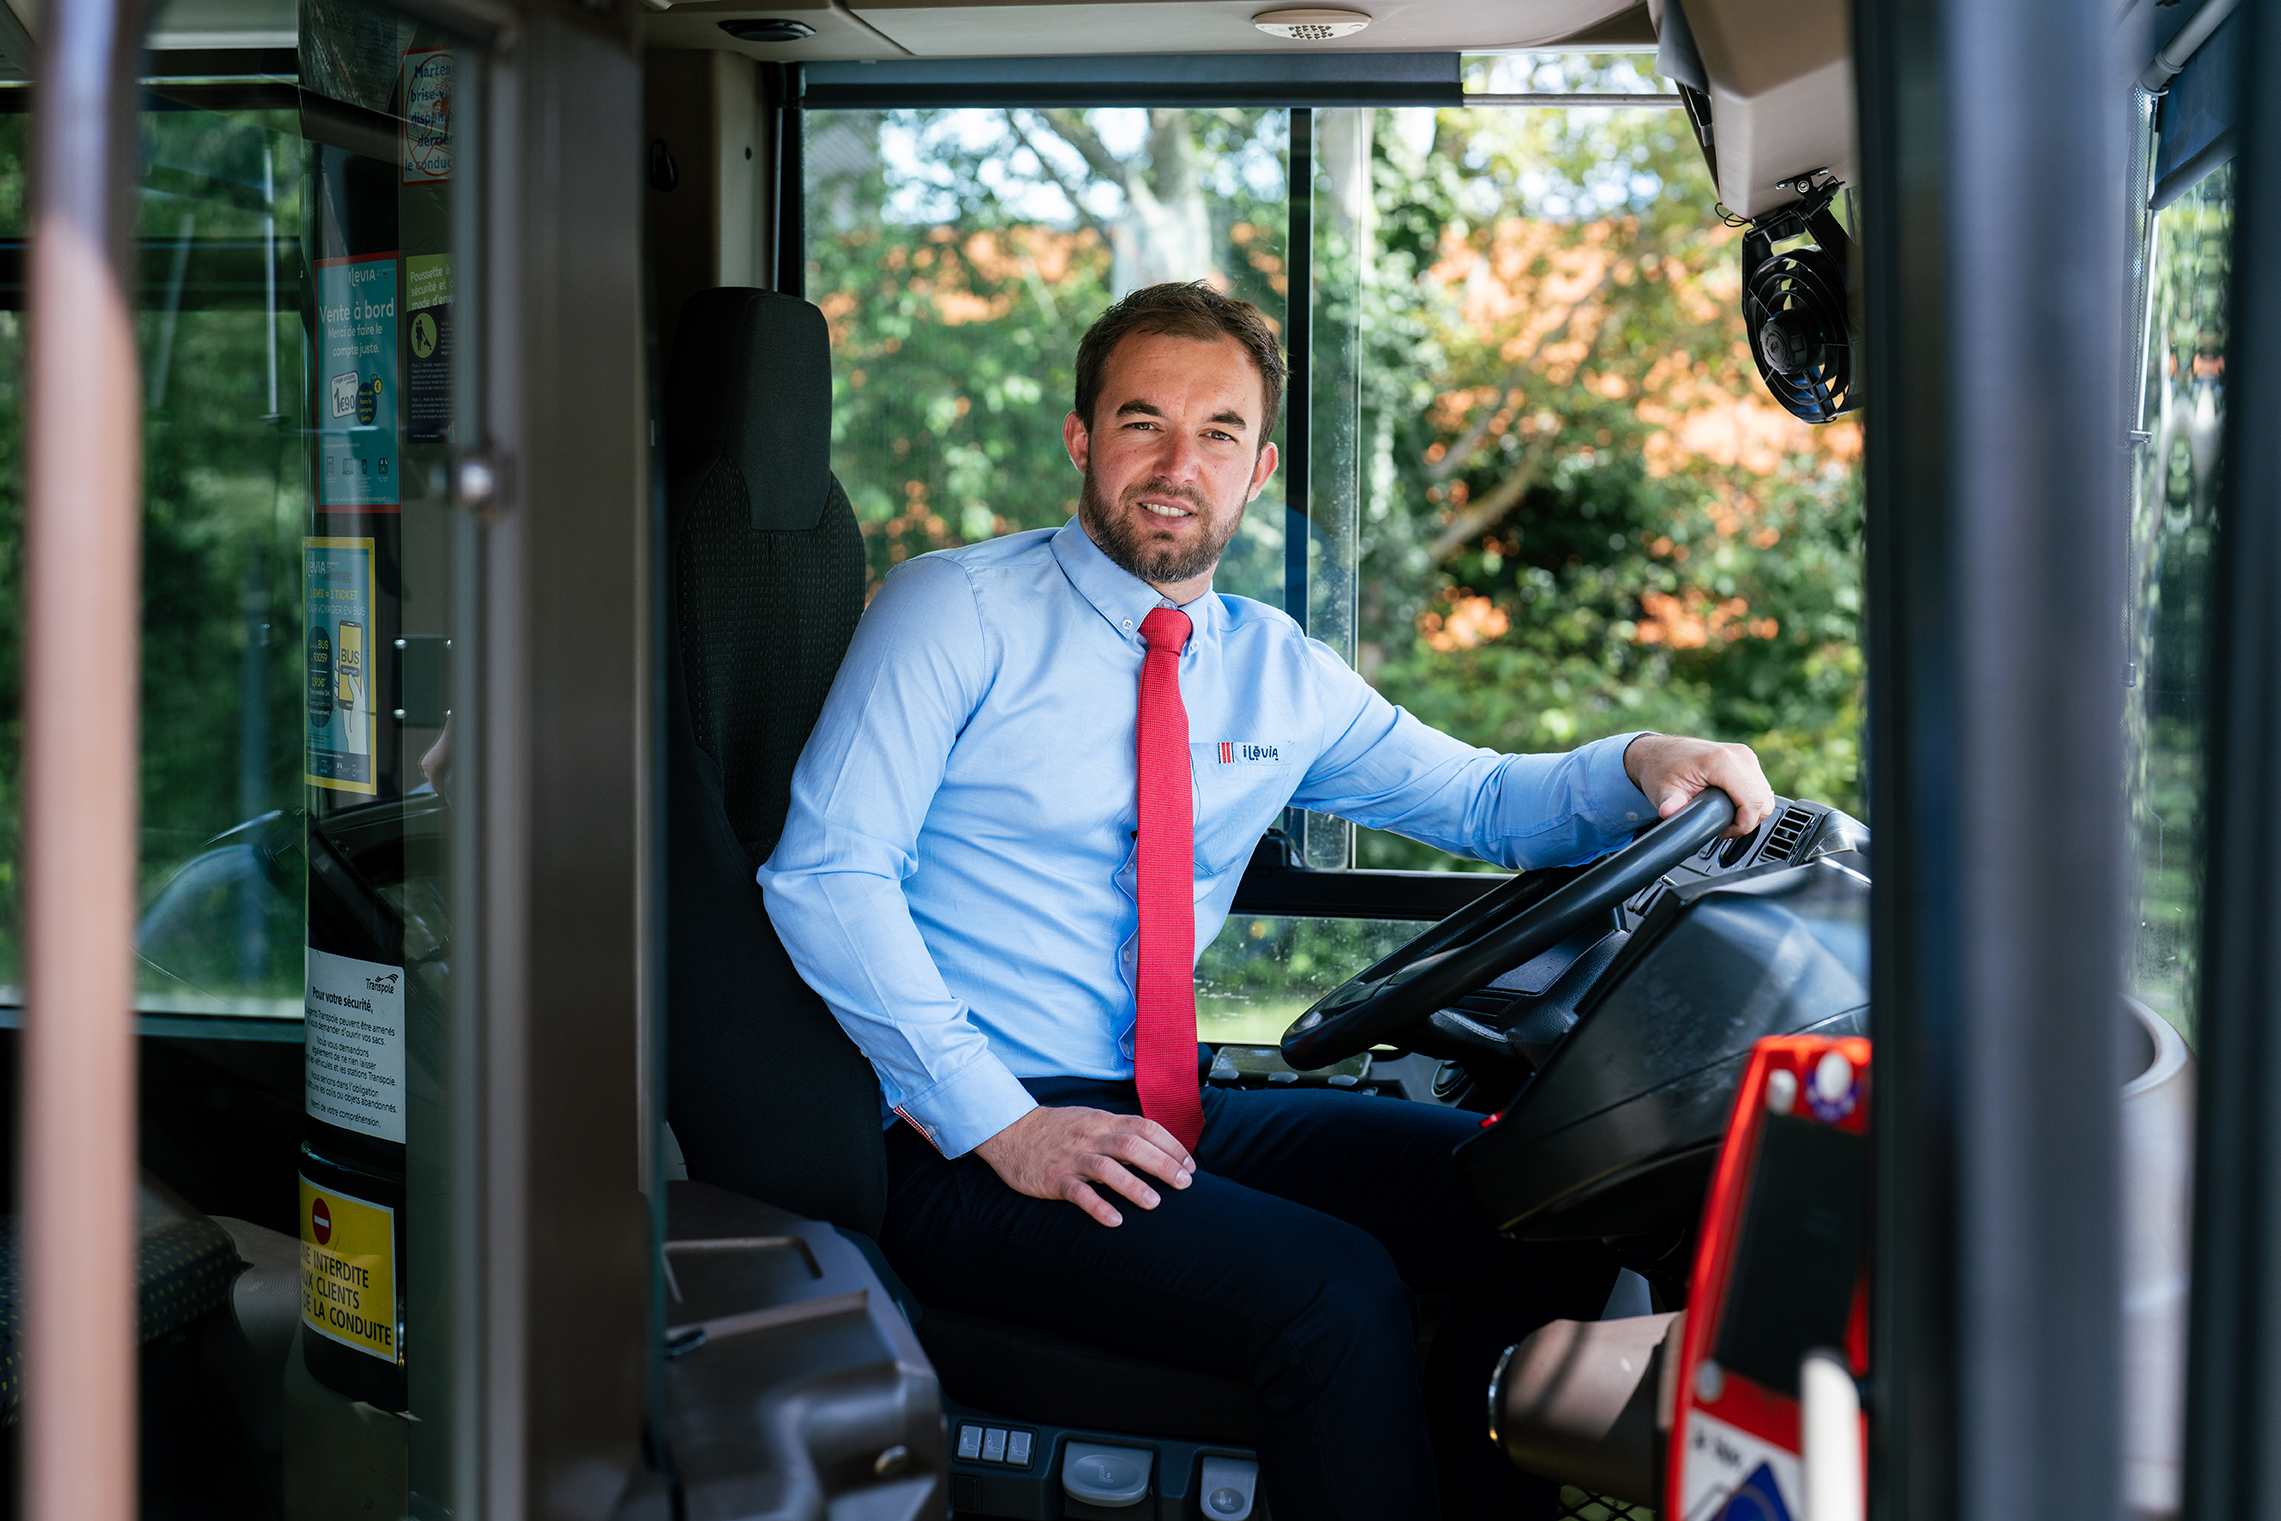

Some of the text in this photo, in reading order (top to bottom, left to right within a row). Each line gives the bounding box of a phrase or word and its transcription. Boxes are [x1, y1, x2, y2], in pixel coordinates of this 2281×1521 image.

[405, 158, 413, 171] le
[410, 266, 443, 282] Poussette
[445, 264, 451, 275] à
[411, 280, 437, 297] sécurité
[439, 279, 447, 290] et
[319, 297, 394, 324] Vente à bord
[412, 297, 431, 310] mode
[327, 322, 383, 339] Merci de faire le
[332, 342, 380, 359] compte juste.
[333, 387, 355, 413] 1€90
[335, 589, 359, 600] TICKET
[318, 604, 343, 615] VOYAGER
[343, 606, 352, 616] EN
[352, 605, 366, 617] BUS
[317, 639, 329, 650] BUS
[341, 647, 360, 665] BUS
[365, 977, 395, 995] Transpole
[312, 985, 374, 1014] Pour votre sécurité,
[318, 1009, 339, 1024] Transpole
[339, 1016, 361, 1030] peuvent
[360, 1020, 372, 1032] être
[372, 1026, 396, 1037] amenés
[318, 1019, 341, 1035] demander
[361, 1034, 372, 1043] vos
[371, 1036, 386, 1046] sacs.
[326, 1041, 339, 1051] vous
[338, 1043, 370, 1058] demandons
[333, 1052, 340, 1062] de
[340, 1055, 348, 1064] ne
[348, 1055, 359, 1067] rien
[359, 1057, 377, 1070] laisser
[333, 1063, 339, 1072] et
[339, 1063, 347, 1075] les
[346, 1067, 368, 1080] stations
[367, 1070, 398, 1086] Transpole.
[336, 1078, 349, 1091] dans
[343, 1092, 361, 1105] objets
[360, 1097, 398, 1114] abandonnés.
[326, 1106, 339, 1117] votre
[338, 1109, 382, 1128] compréhension.
[313, 1249, 369, 1289] INTERDITE
[316, 1276, 360, 1310] CLIENTS
[313, 1297, 326, 1321] LA
[329, 1306, 392, 1347] CONDUITE
